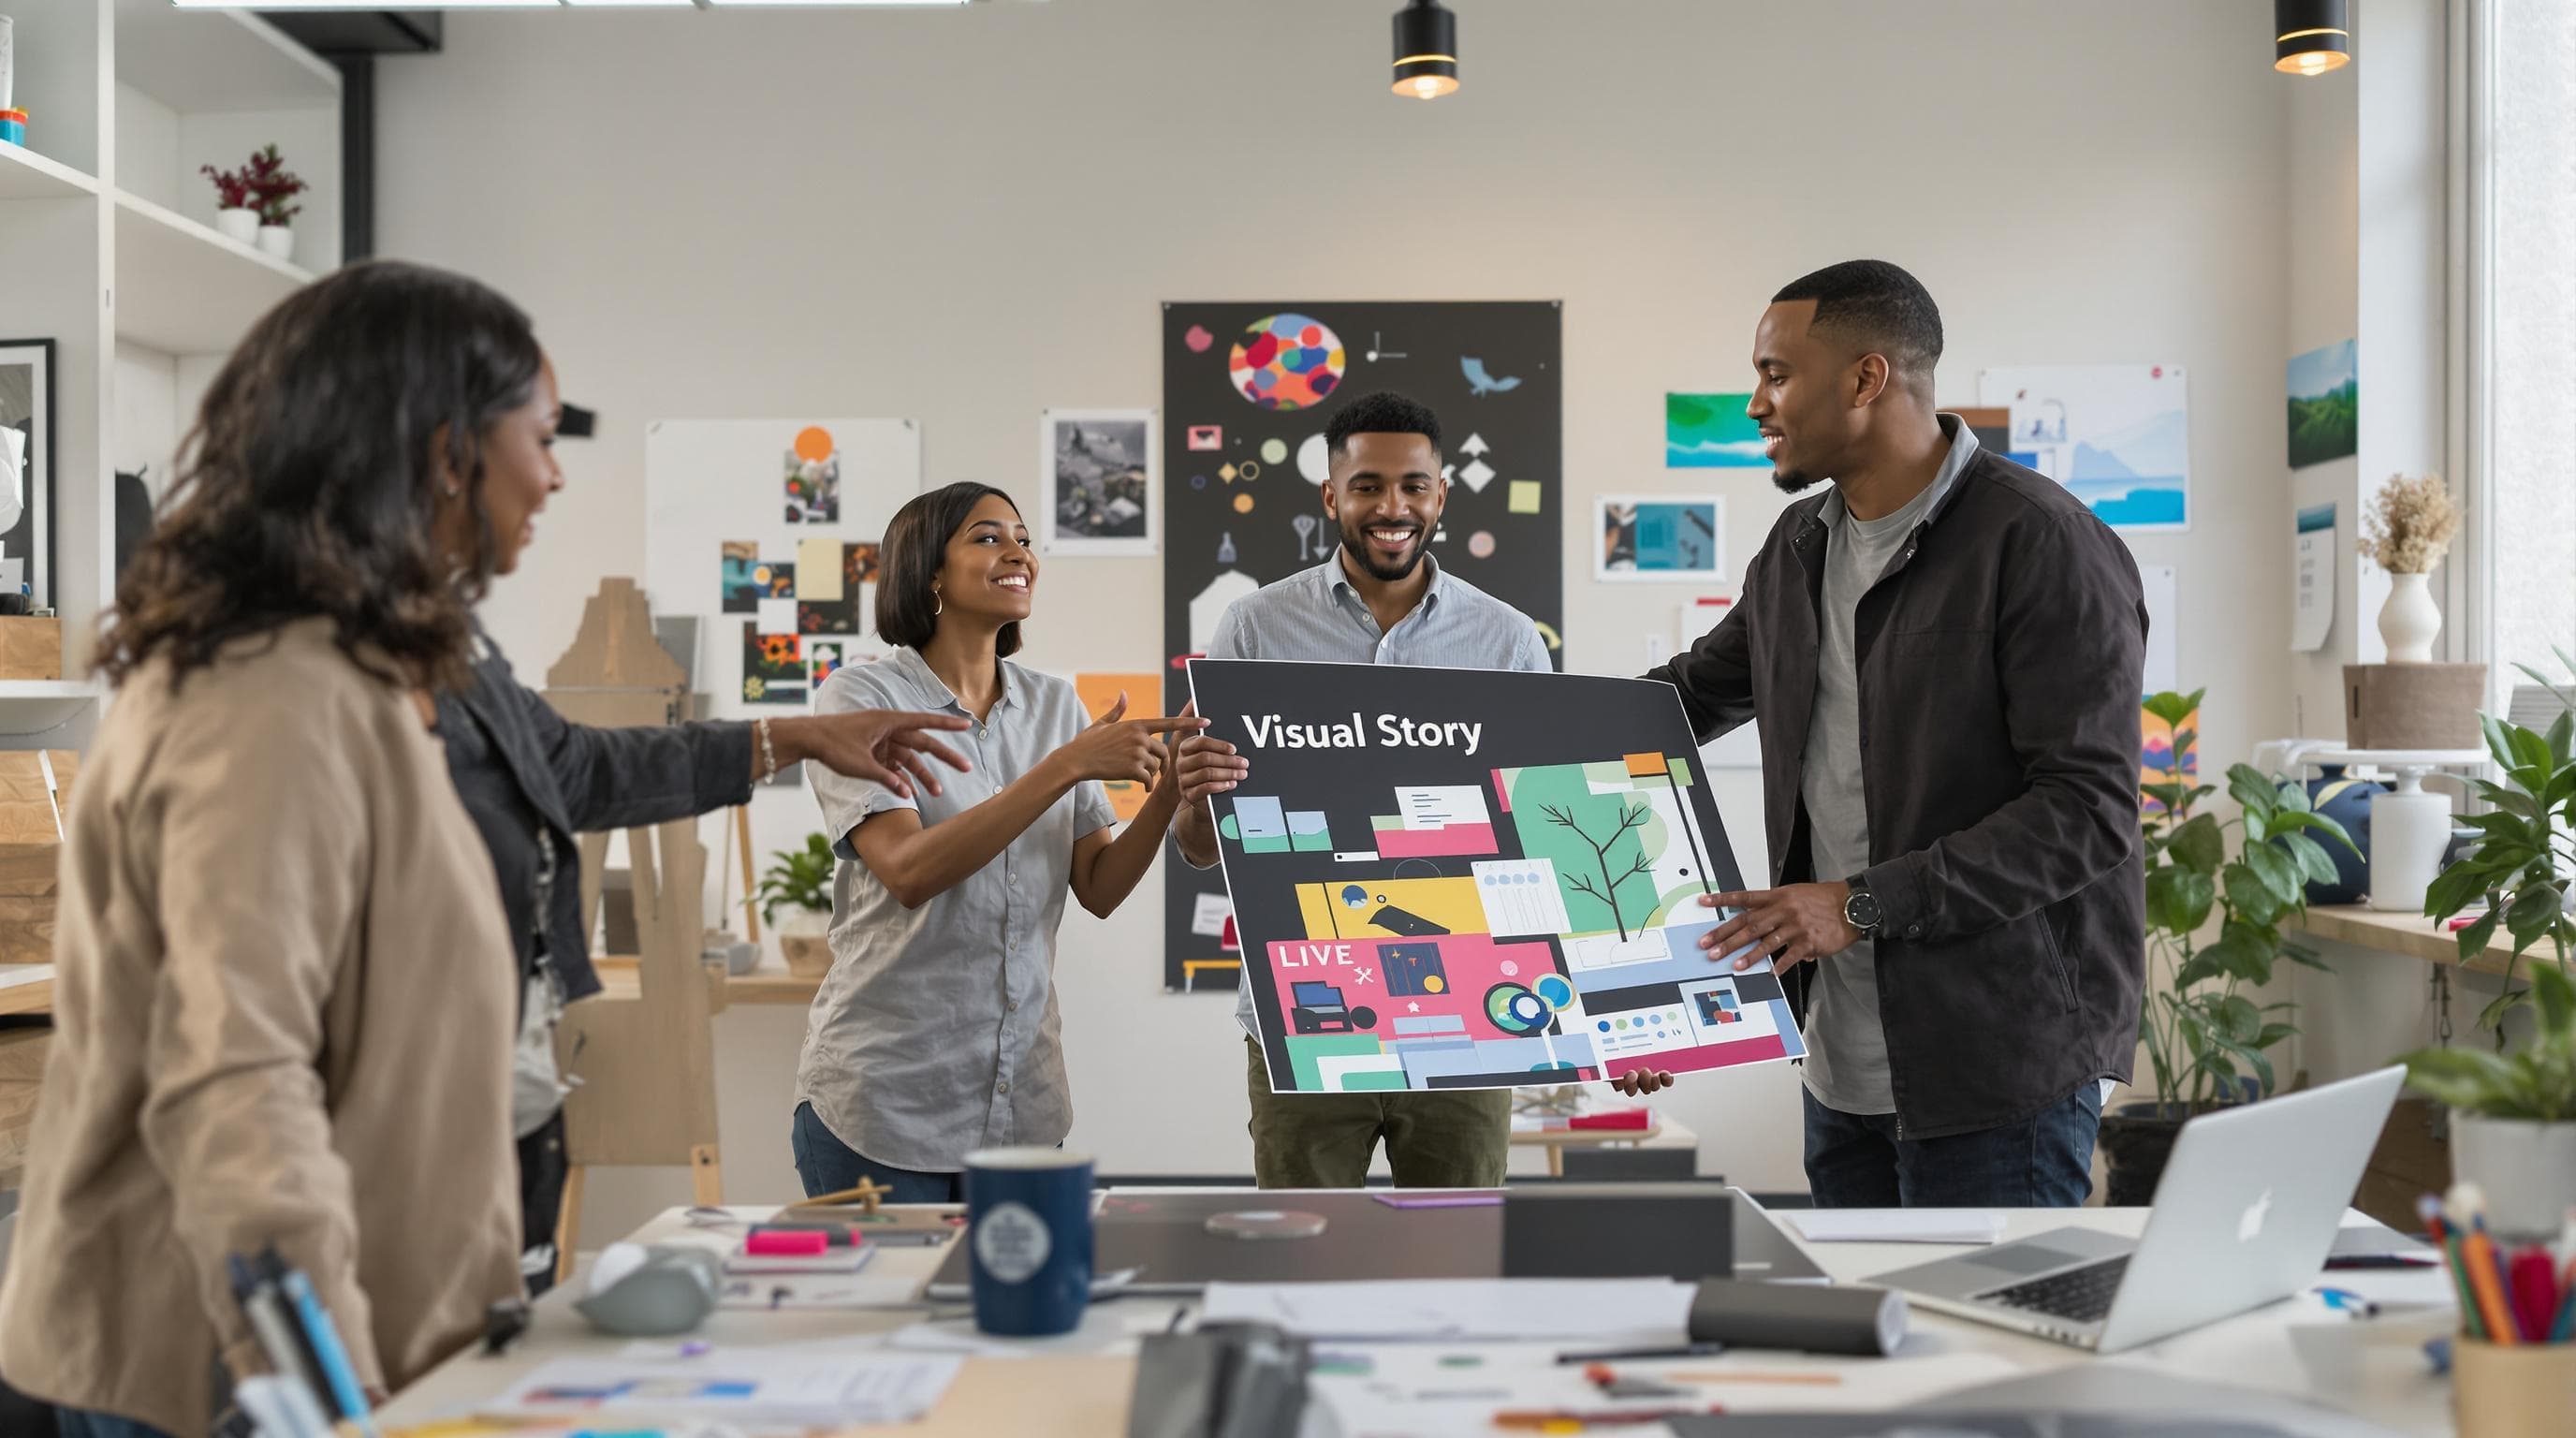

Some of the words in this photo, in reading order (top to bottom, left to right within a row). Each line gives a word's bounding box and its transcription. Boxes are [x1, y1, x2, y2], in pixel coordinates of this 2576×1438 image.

[1241, 712, 1367, 749] Visual
[1376, 713, 1482, 756] Story
[1279, 945, 1354, 968] LIVE
